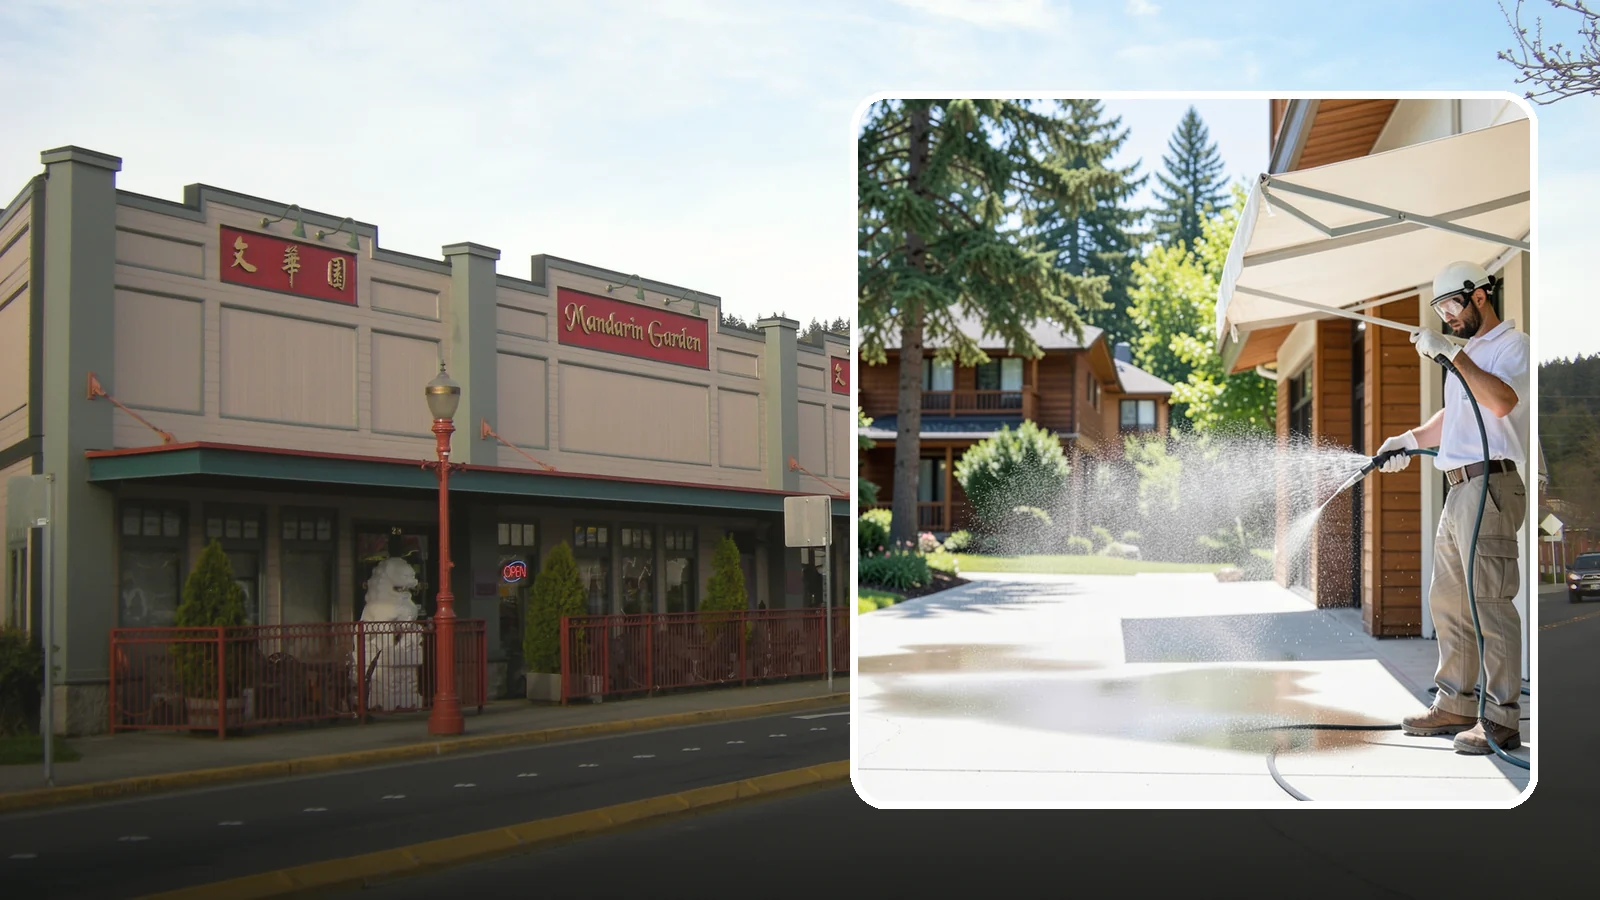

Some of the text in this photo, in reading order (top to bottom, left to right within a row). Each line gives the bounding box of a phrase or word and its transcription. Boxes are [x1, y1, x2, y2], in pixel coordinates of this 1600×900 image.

[231, 236, 346, 291] 文華園
[565, 303, 701, 352] Mandarin Garden
[503, 565, 527, 578] OPEN
